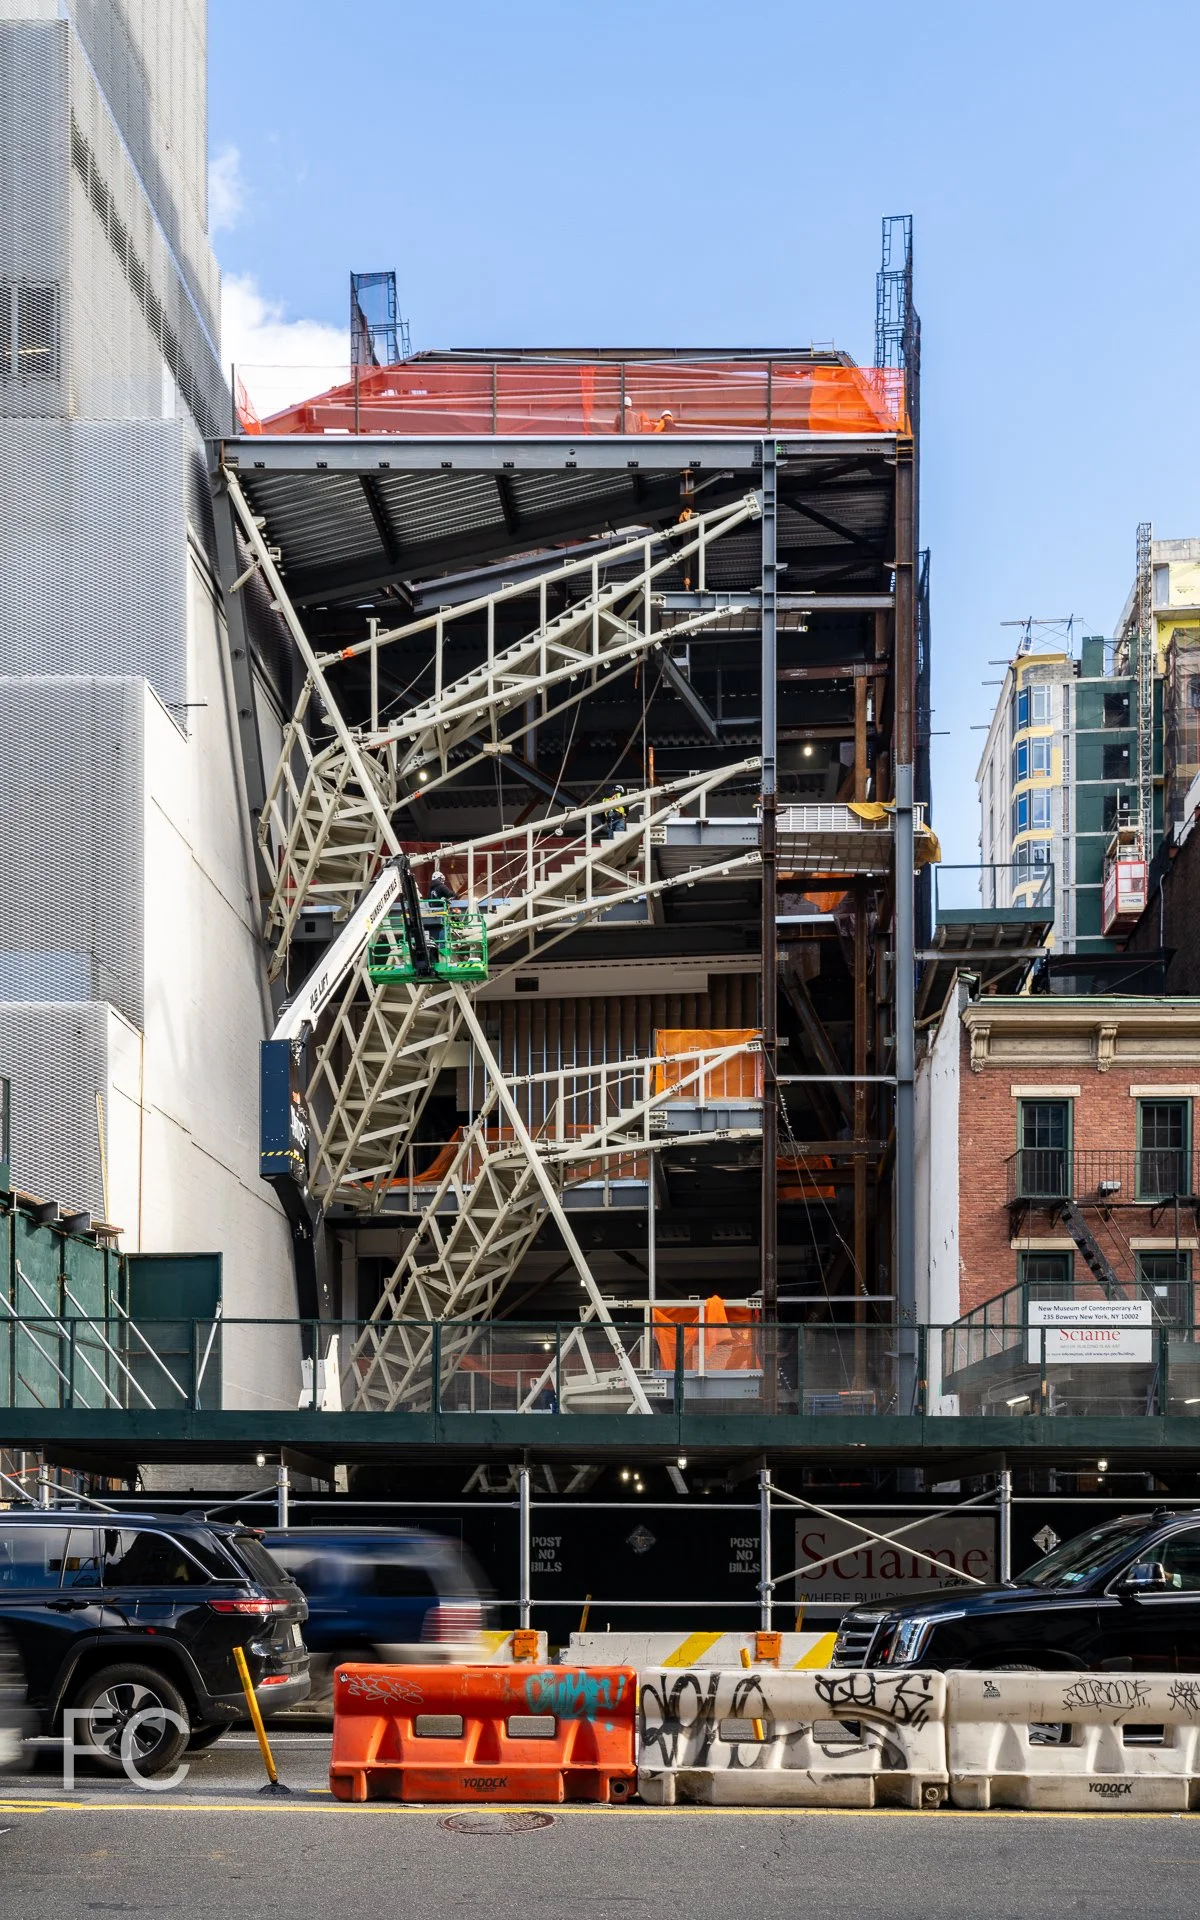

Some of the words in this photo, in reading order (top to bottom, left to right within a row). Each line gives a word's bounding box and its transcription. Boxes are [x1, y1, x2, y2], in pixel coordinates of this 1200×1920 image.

[1088, 1305, 1131, 1313] Contemporary
[1059, 1328, 1121, 1341] Sciame
[532, 1536, 562, 1547] POST
[730, 1537, 760, 1548] POST
[539, 1549, 555, 1559] NO
[736, 1550, 753, 1560] NO
[800, 1532, 989, 1580] Sciame
[531, 1562, 562, 1572] BILLS
[729, 1562, 760, 1573] BILLS
[803, 1592, 850, 1602] WHERE
[464, 1777, 507, 1788] YODOCK
[1089, 1783, 1132, 1793] YODOCK
